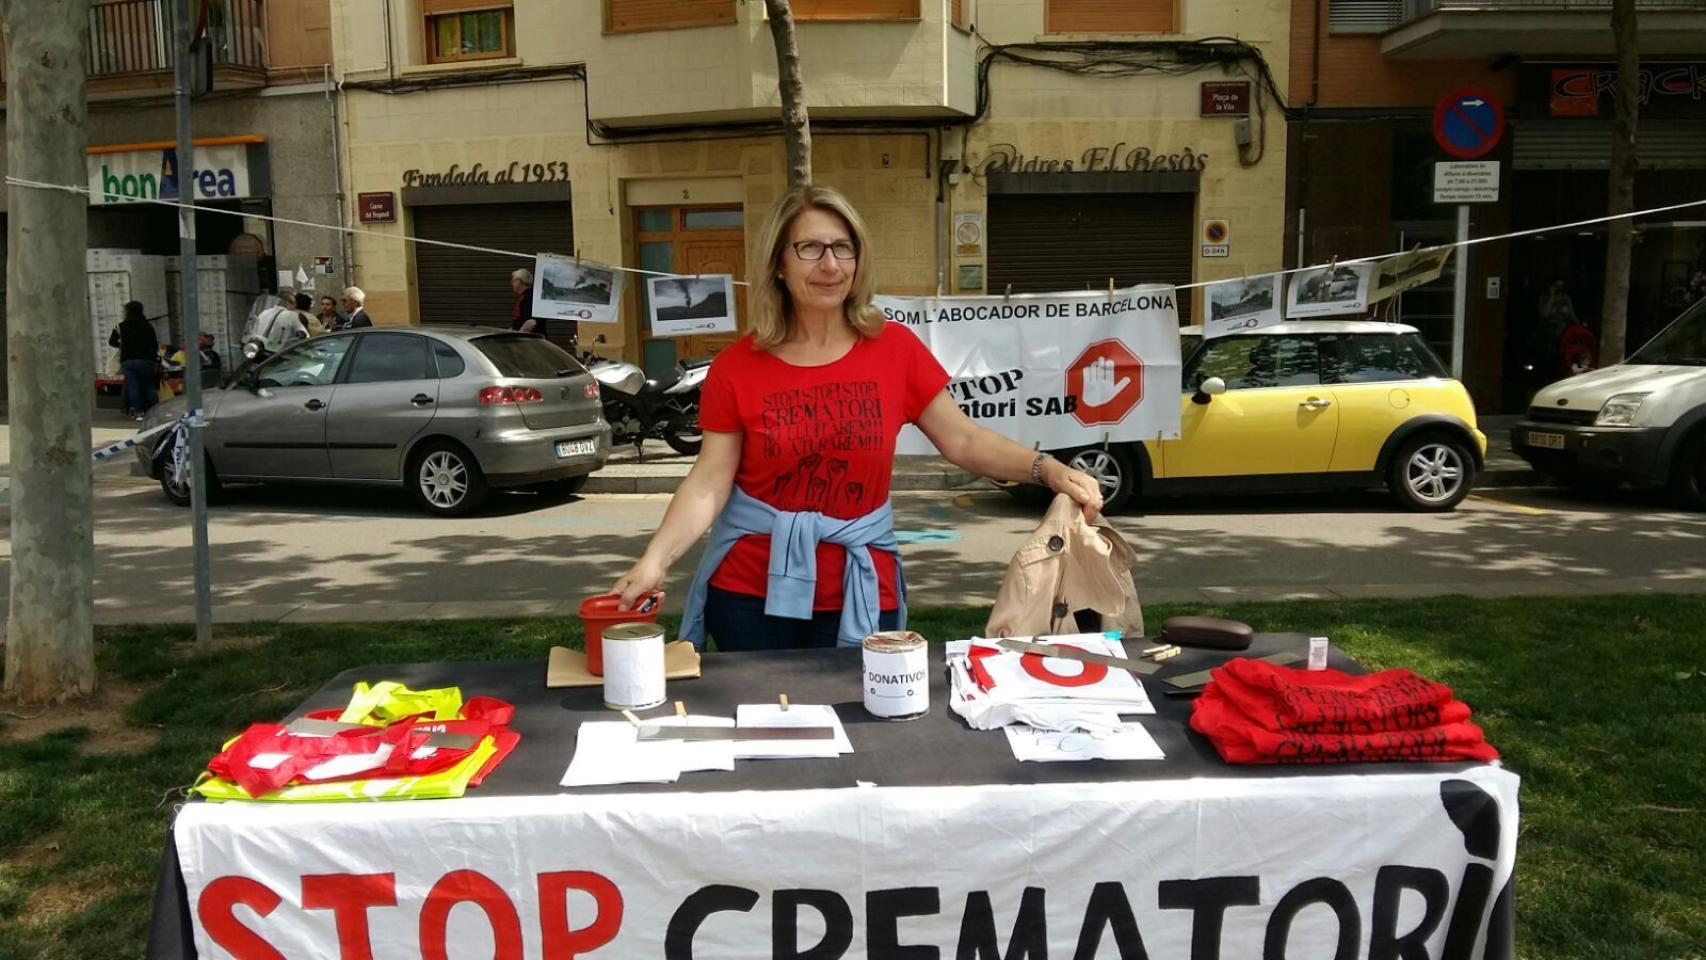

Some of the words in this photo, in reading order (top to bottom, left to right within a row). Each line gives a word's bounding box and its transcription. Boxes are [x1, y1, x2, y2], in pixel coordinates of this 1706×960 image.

[1081, 142, 1126, 172] El
[1126, 146, 1209, 173] Besòs
[403, 163, 490, 188] Fundada
[494, 161, 518, 185] al
[521, 160, 569, 183] 1953
[883, 306, 921, 325] SOM
[1045, 303, 1070, 318] DE
[1075, 295, 1175, 317] BARCELONA
[761, 398, 882, 429] CREMATORI
[958, 398, 1016, 419] atori
[1025, 394, 1078, 417] SAB
[198, 868, 624, 960] STOP
